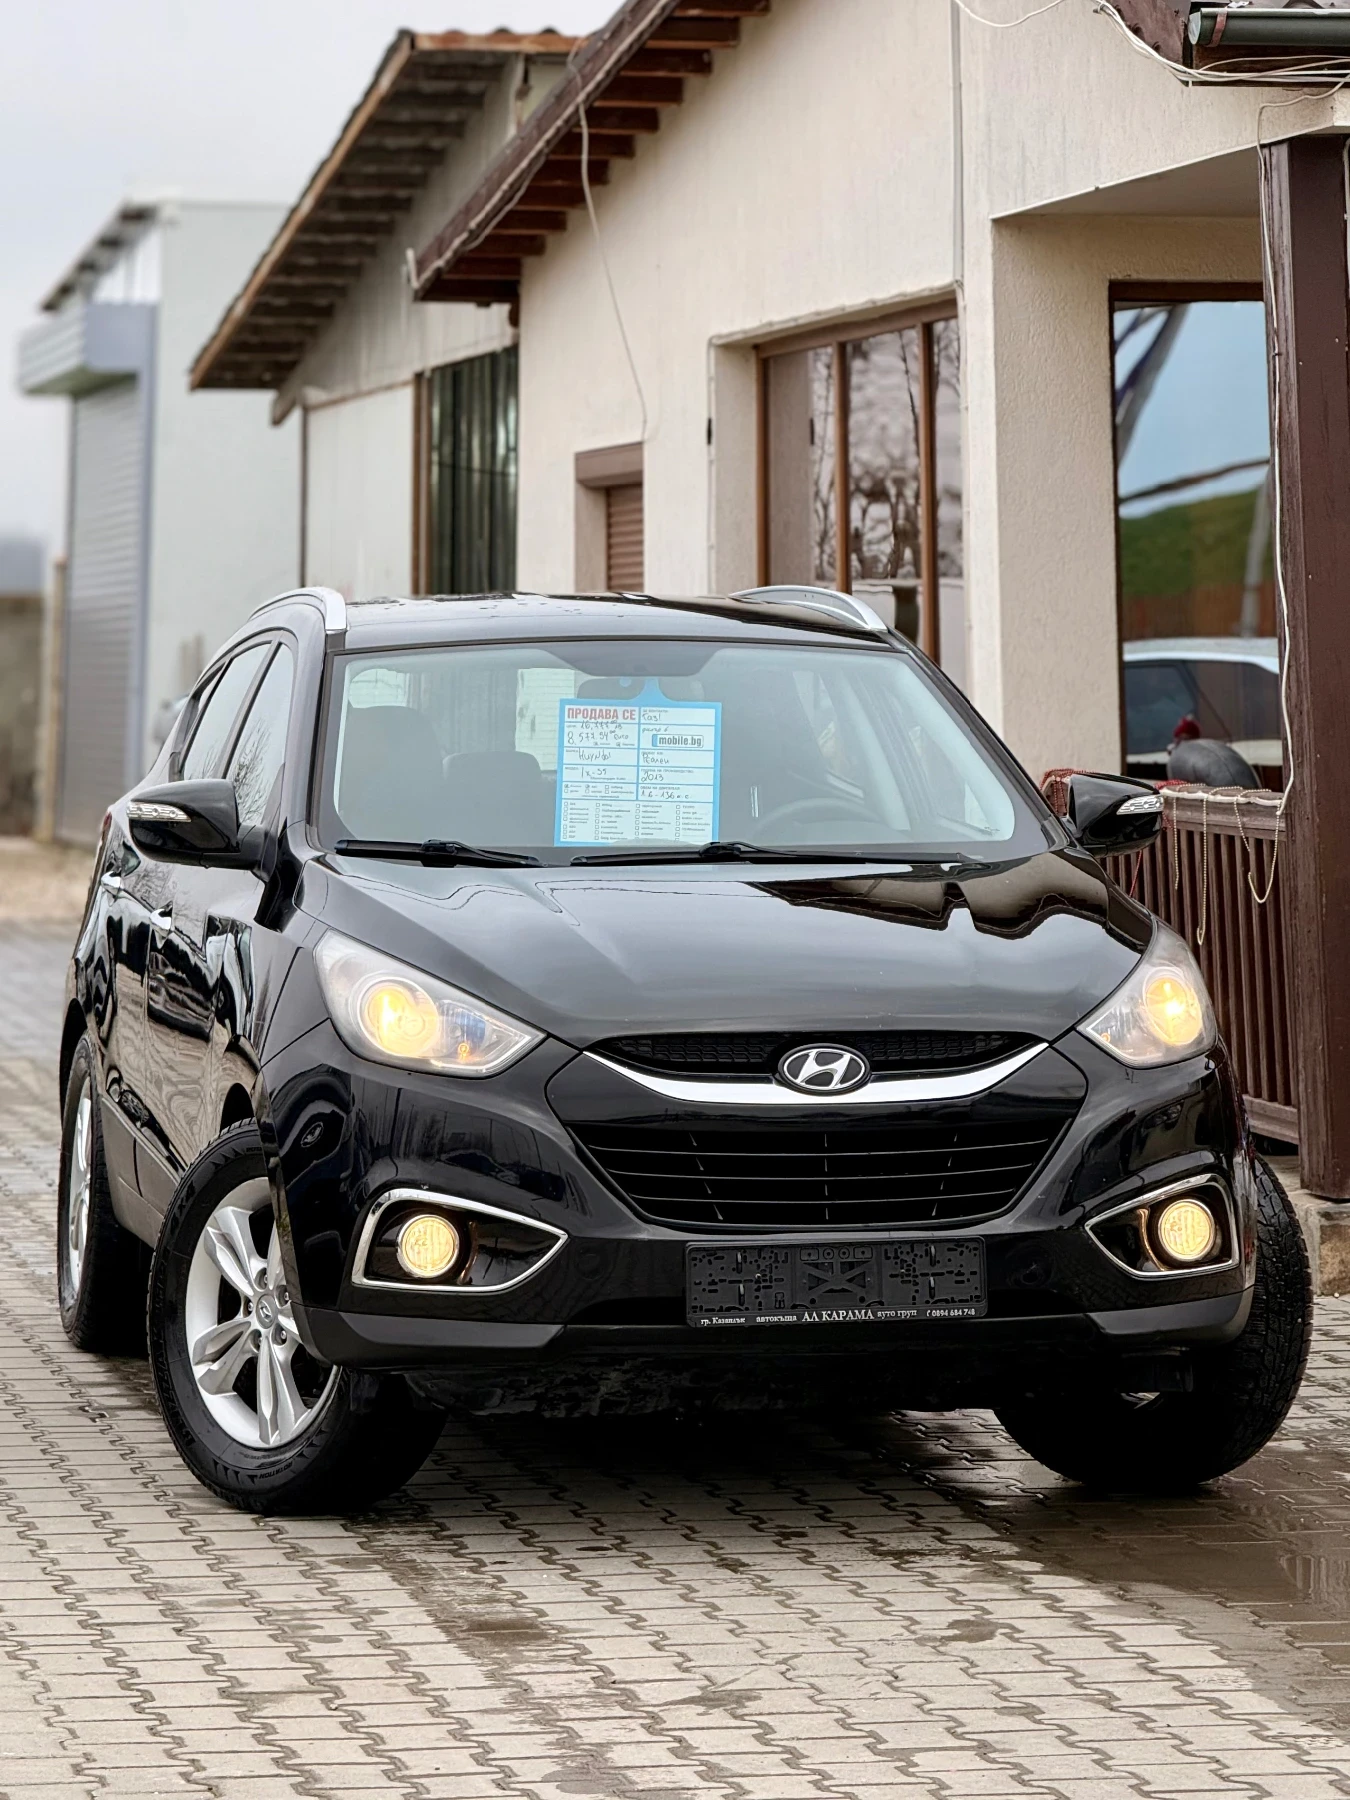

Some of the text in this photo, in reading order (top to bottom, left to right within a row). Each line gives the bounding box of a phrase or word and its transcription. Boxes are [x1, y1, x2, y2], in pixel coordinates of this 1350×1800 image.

[567, 707, 636, 720] ПРОДАВА СЕ
[658, 735, 702, 747] mobile.bg
[640, 771, 664, 782] 2013
[700, 1318, 711, 1326] гр.
[712, 1316, 746, 1324] Казанлък
[755, 1315, 798, 1323] автокъща
[801, 1311, 820, 1322] АЛ
[821, 1309, 875, 1321] КАРАМА
[897, 1309, 918, 1318] груп
[931, 1308, 949, 1317] 0894
[949, 1308, 963, 1316] 684
